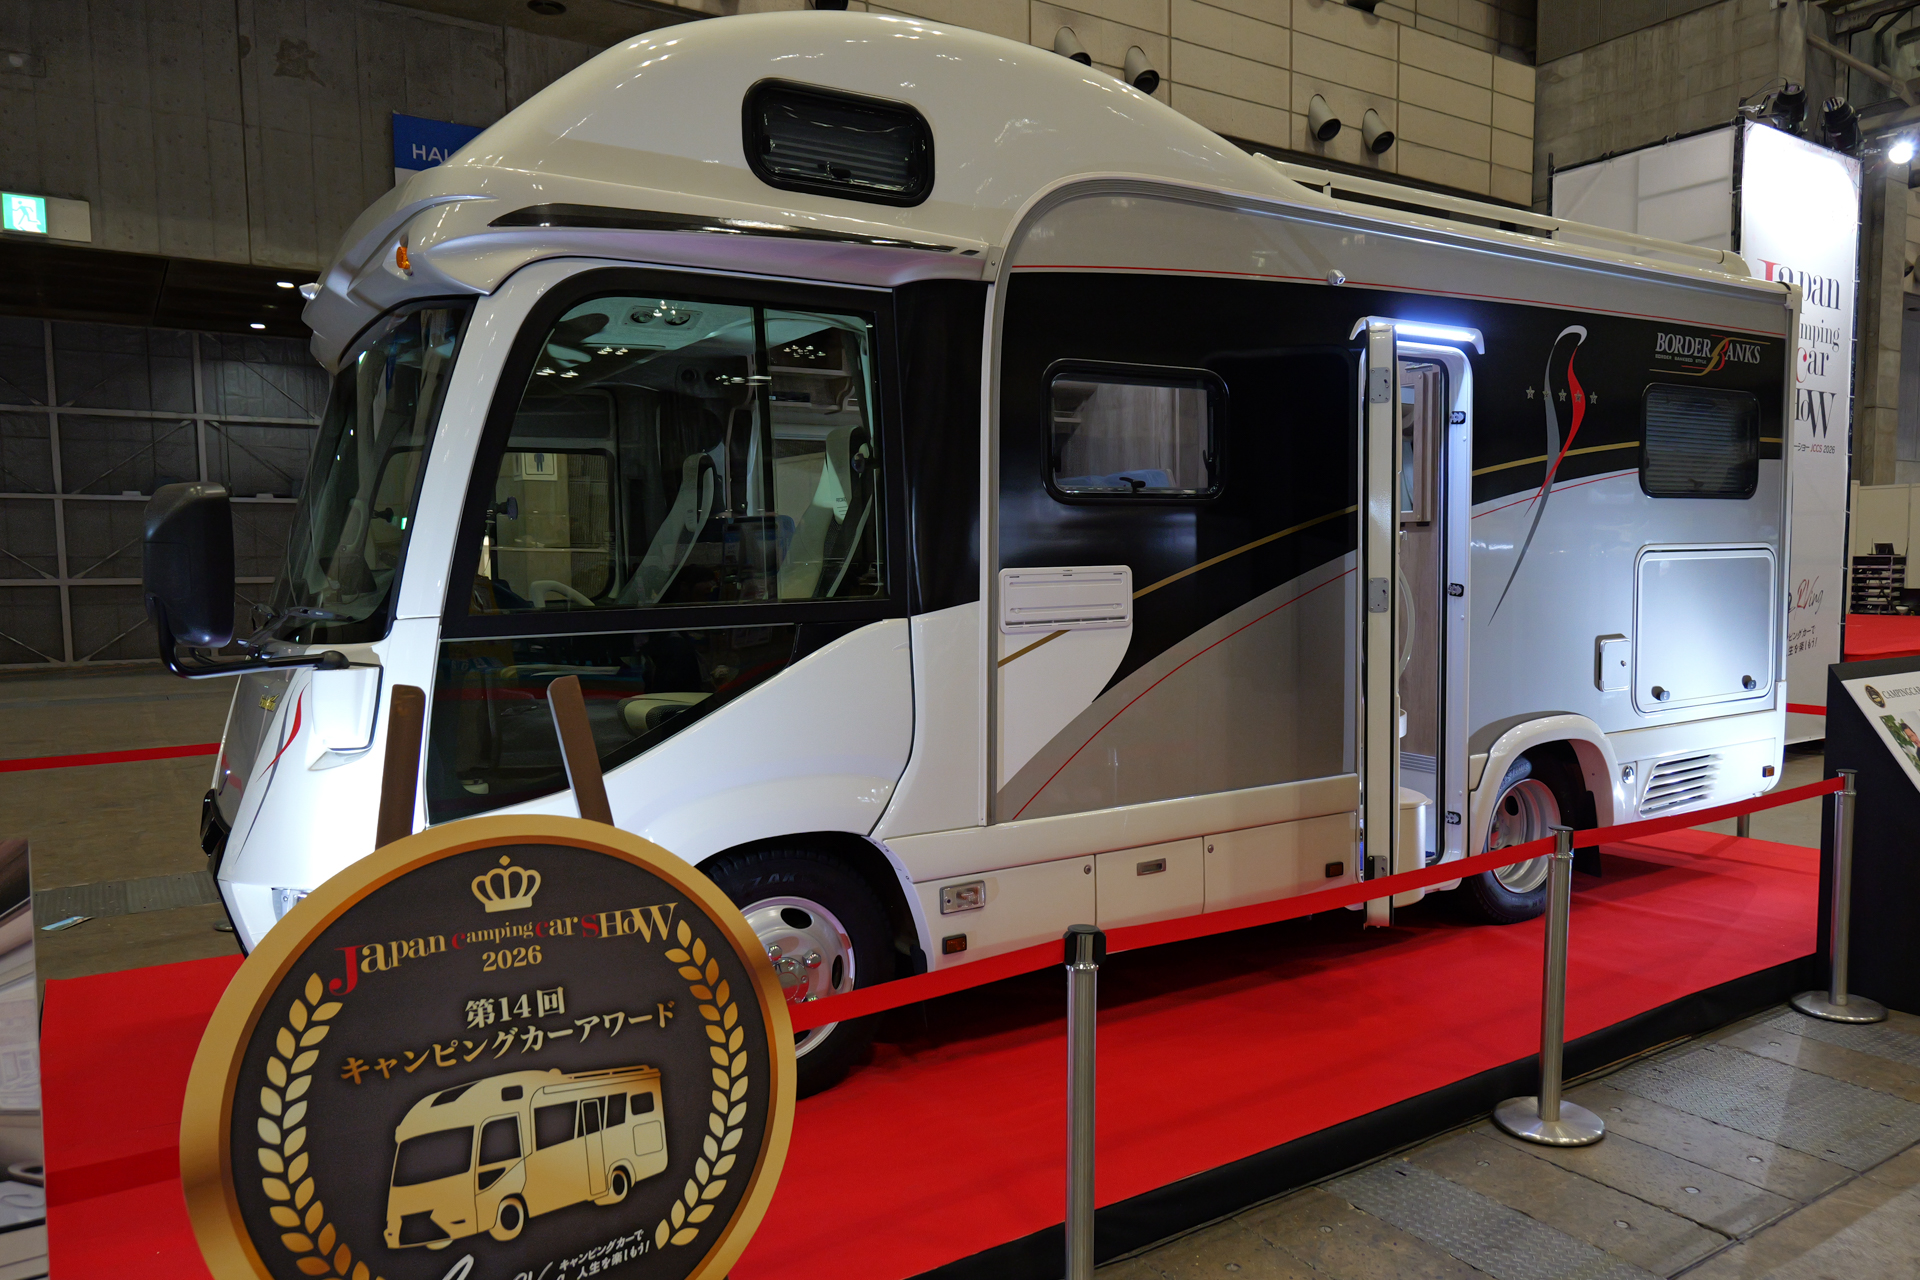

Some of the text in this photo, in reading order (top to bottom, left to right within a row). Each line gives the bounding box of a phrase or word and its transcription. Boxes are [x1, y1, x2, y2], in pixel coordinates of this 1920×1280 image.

[1655, 332, 1711, 358] BORDER
[1823, 445, 1835, 454] 2026
[328, 934, 448, 996] Japan
[481, 945, 543, 972] 2026
[465, 986, 566, 1029] 第14回
[340, 1001, 675, 1085] キャンピングカーアワード
